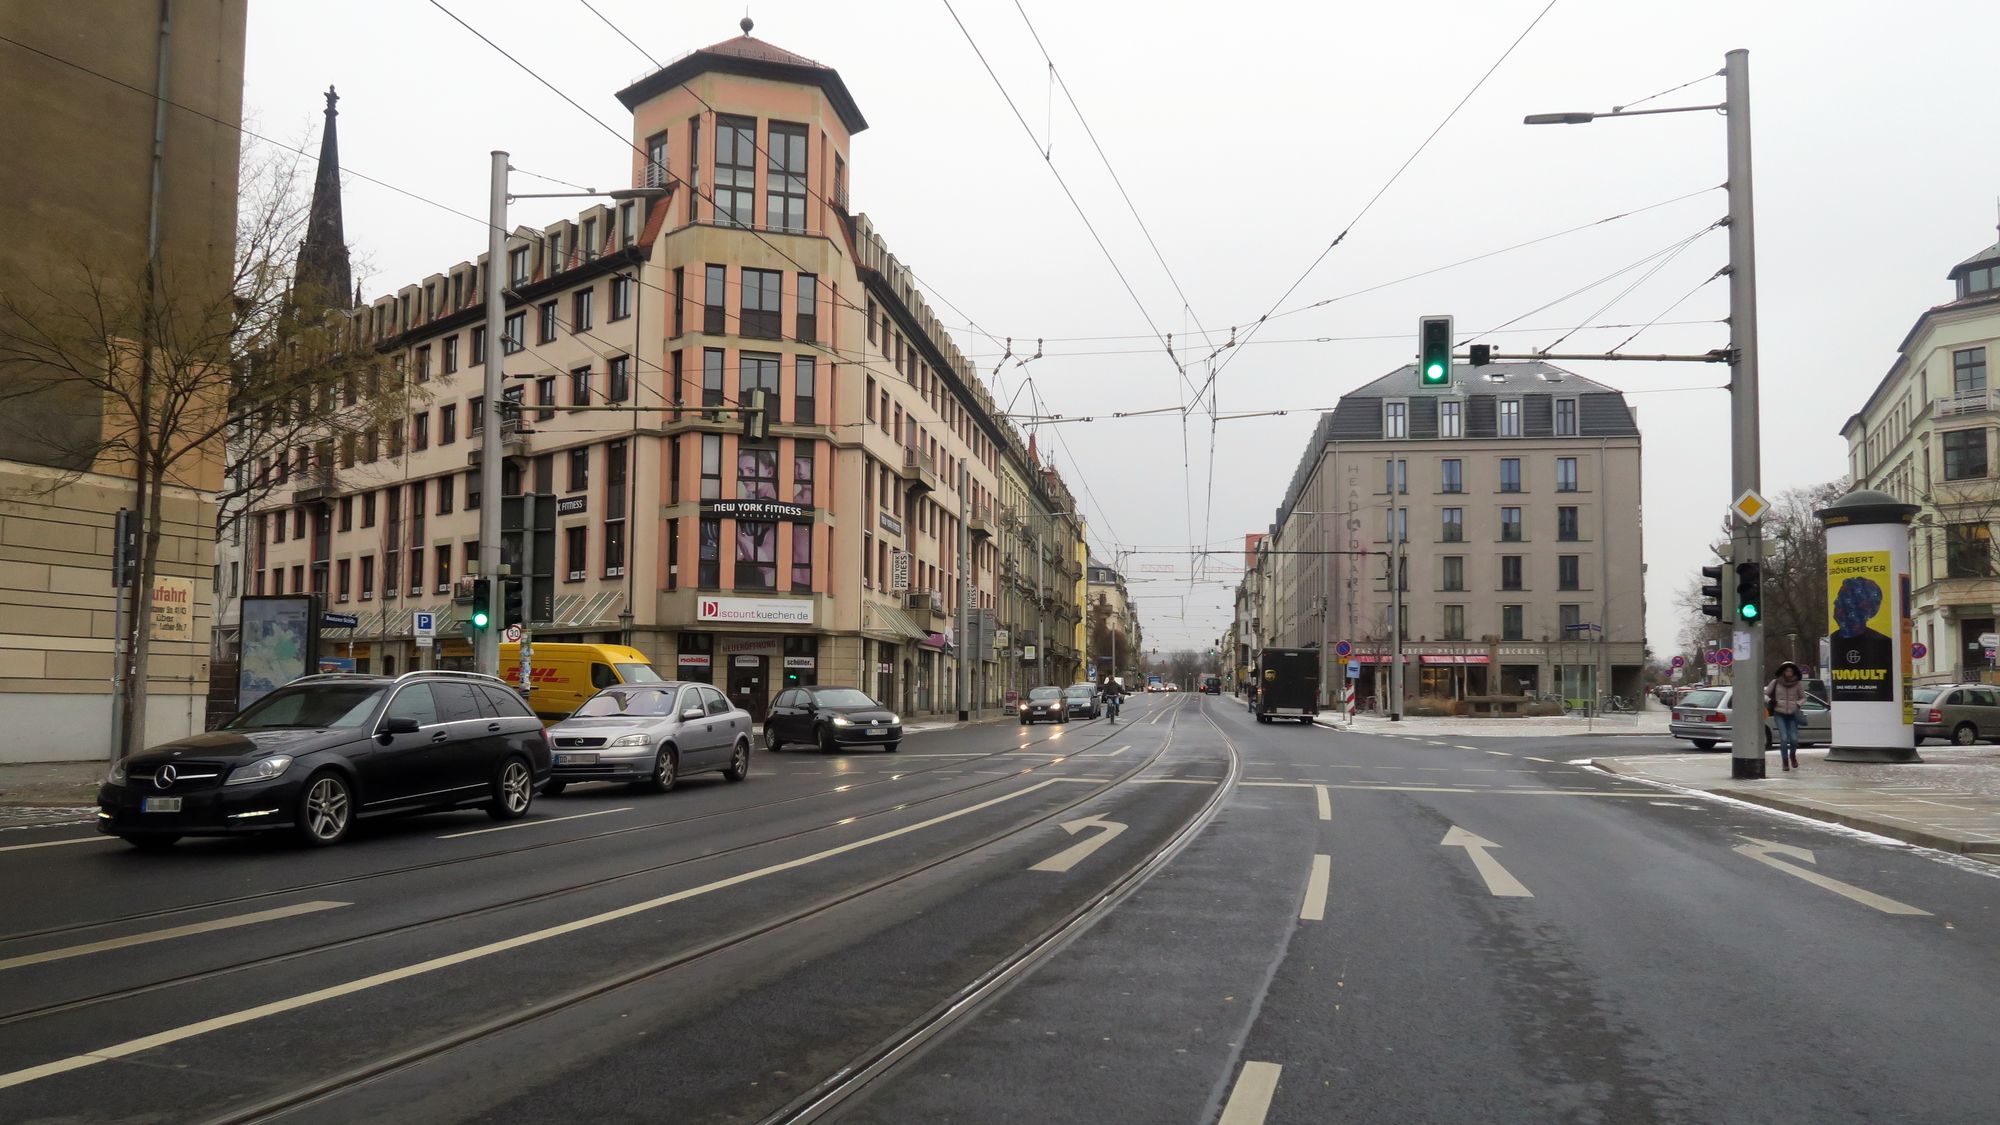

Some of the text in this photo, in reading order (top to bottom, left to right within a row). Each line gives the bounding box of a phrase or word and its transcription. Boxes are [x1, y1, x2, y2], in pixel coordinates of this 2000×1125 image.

[562, 500, 583, 510] FITNESS
[714, 503, 802, 516] NEW YORK FITNESS
[1834, 556, 1874, 564] HERBERT
[152, 586, 186, 602] ufahrt
[510, 628, 518, 638] 30
[1832, 669, 1887, 680] TUMULT
